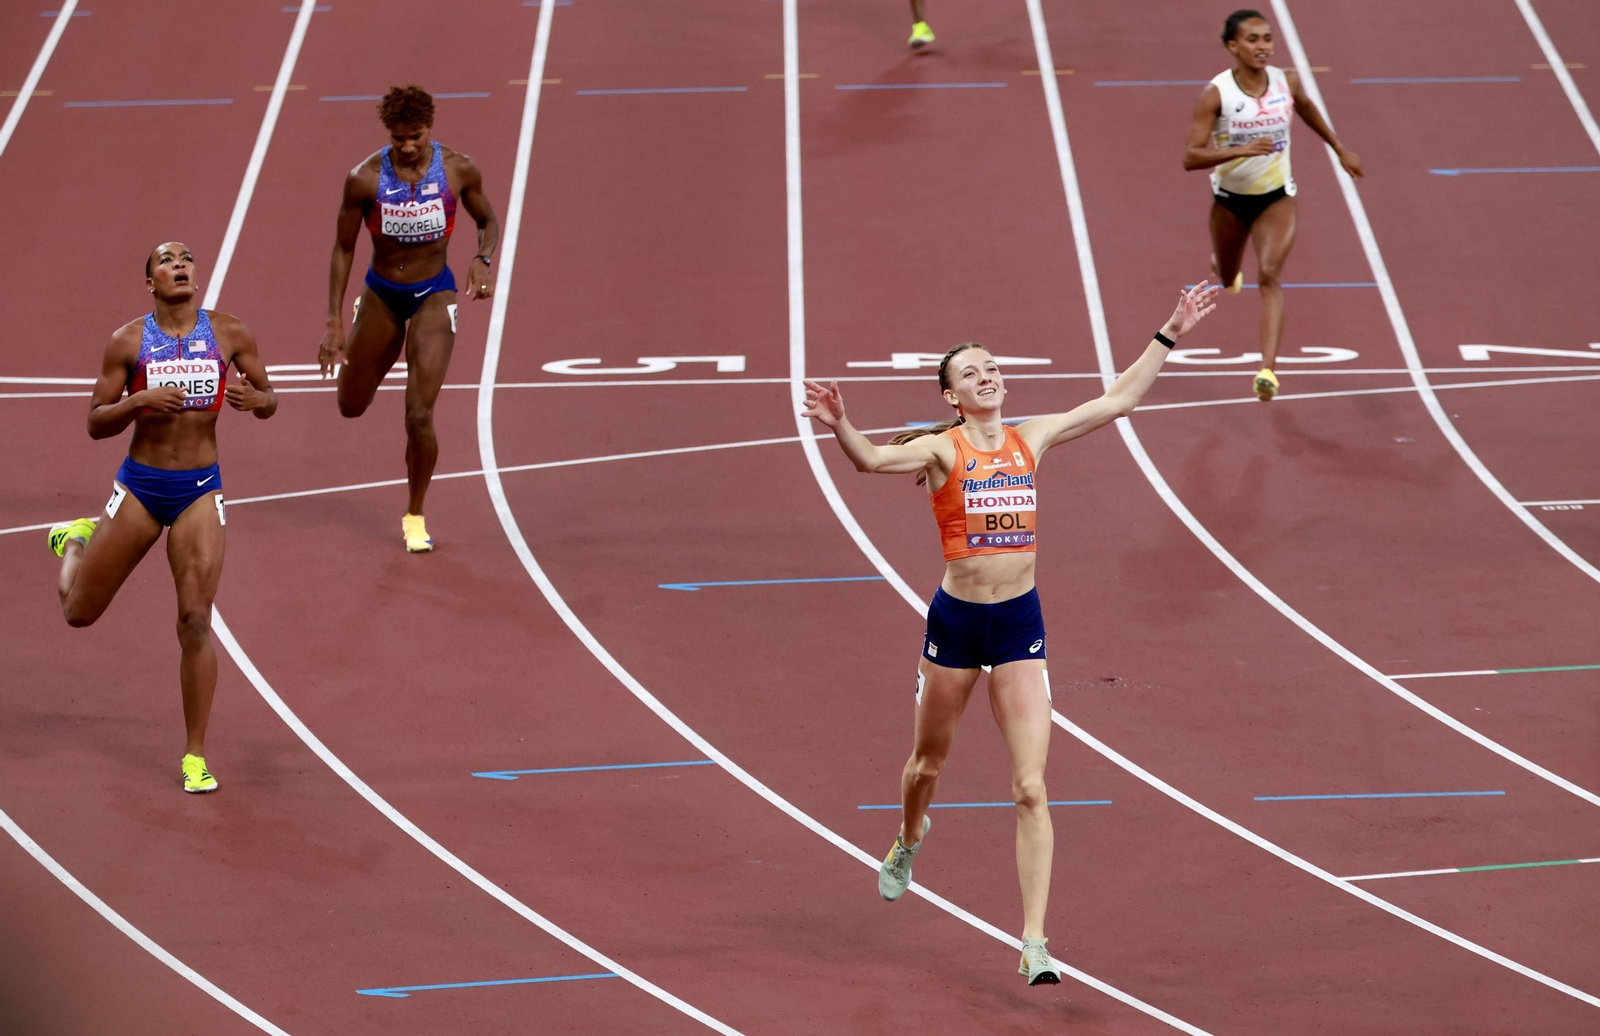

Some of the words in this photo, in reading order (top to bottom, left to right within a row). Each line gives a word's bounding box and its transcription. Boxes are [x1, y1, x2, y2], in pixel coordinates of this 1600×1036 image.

[1231, 117, 1285, 128] HONDA
[383, 204, 441, 218] HONDA
[385, 217, 443, 234] COCKRELL
[148, 364, 216, 375] HONDA
[541, 355, 746, 375] 5
[967, 495, 1035, 508] HONDA
[985, 512, 1026, 531] BOL
